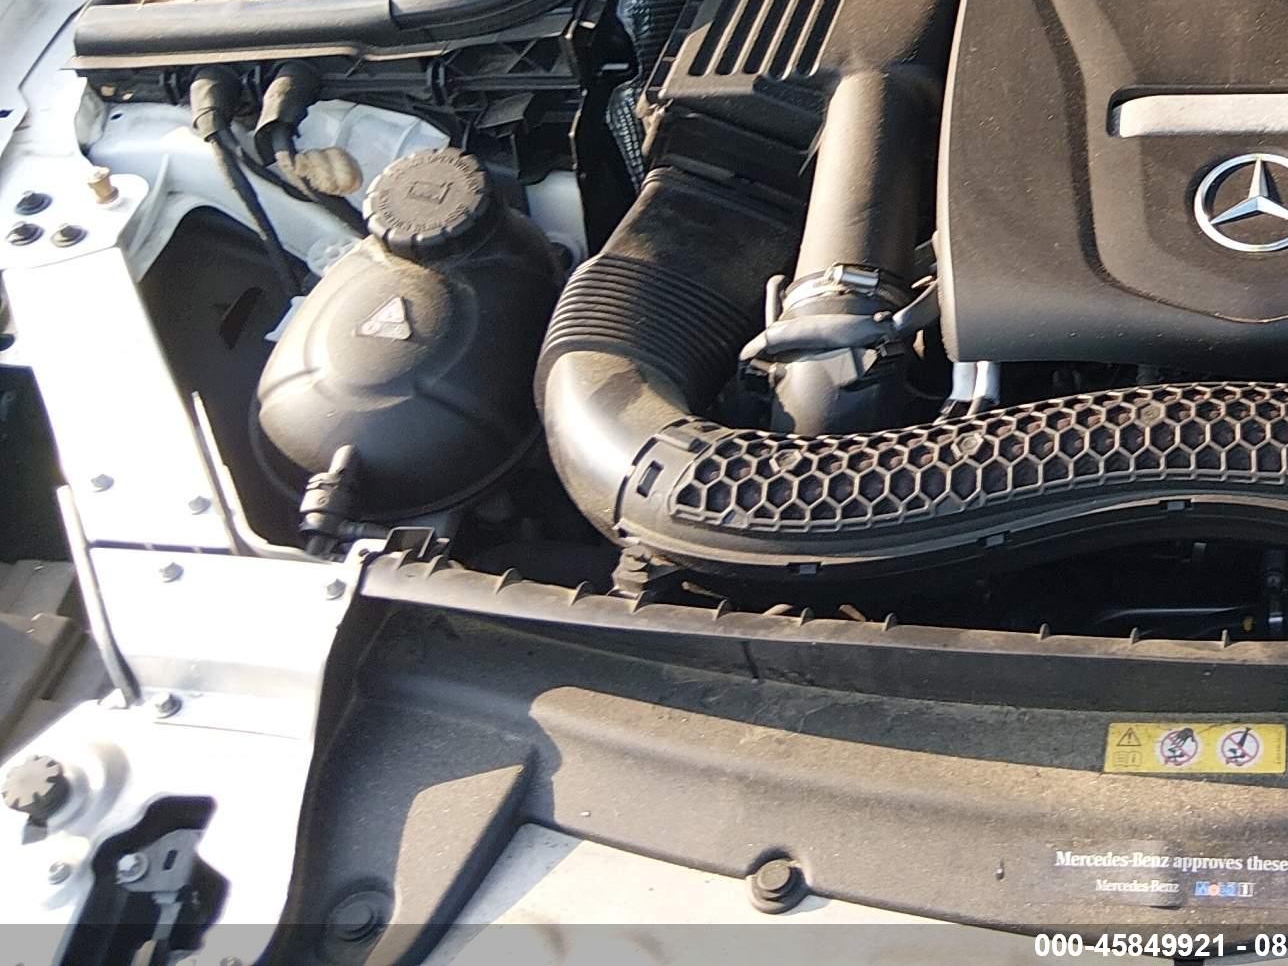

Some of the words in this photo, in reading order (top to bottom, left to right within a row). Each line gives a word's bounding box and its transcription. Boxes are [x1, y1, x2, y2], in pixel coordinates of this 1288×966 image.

[1055, 850, 1170, 868] Mercedes-Benz
[1173, 856, 1243, 872] approves
[1247, 855, 1288, 872] these
[1095, 879, 1180, 893] Mercedes-Benz
